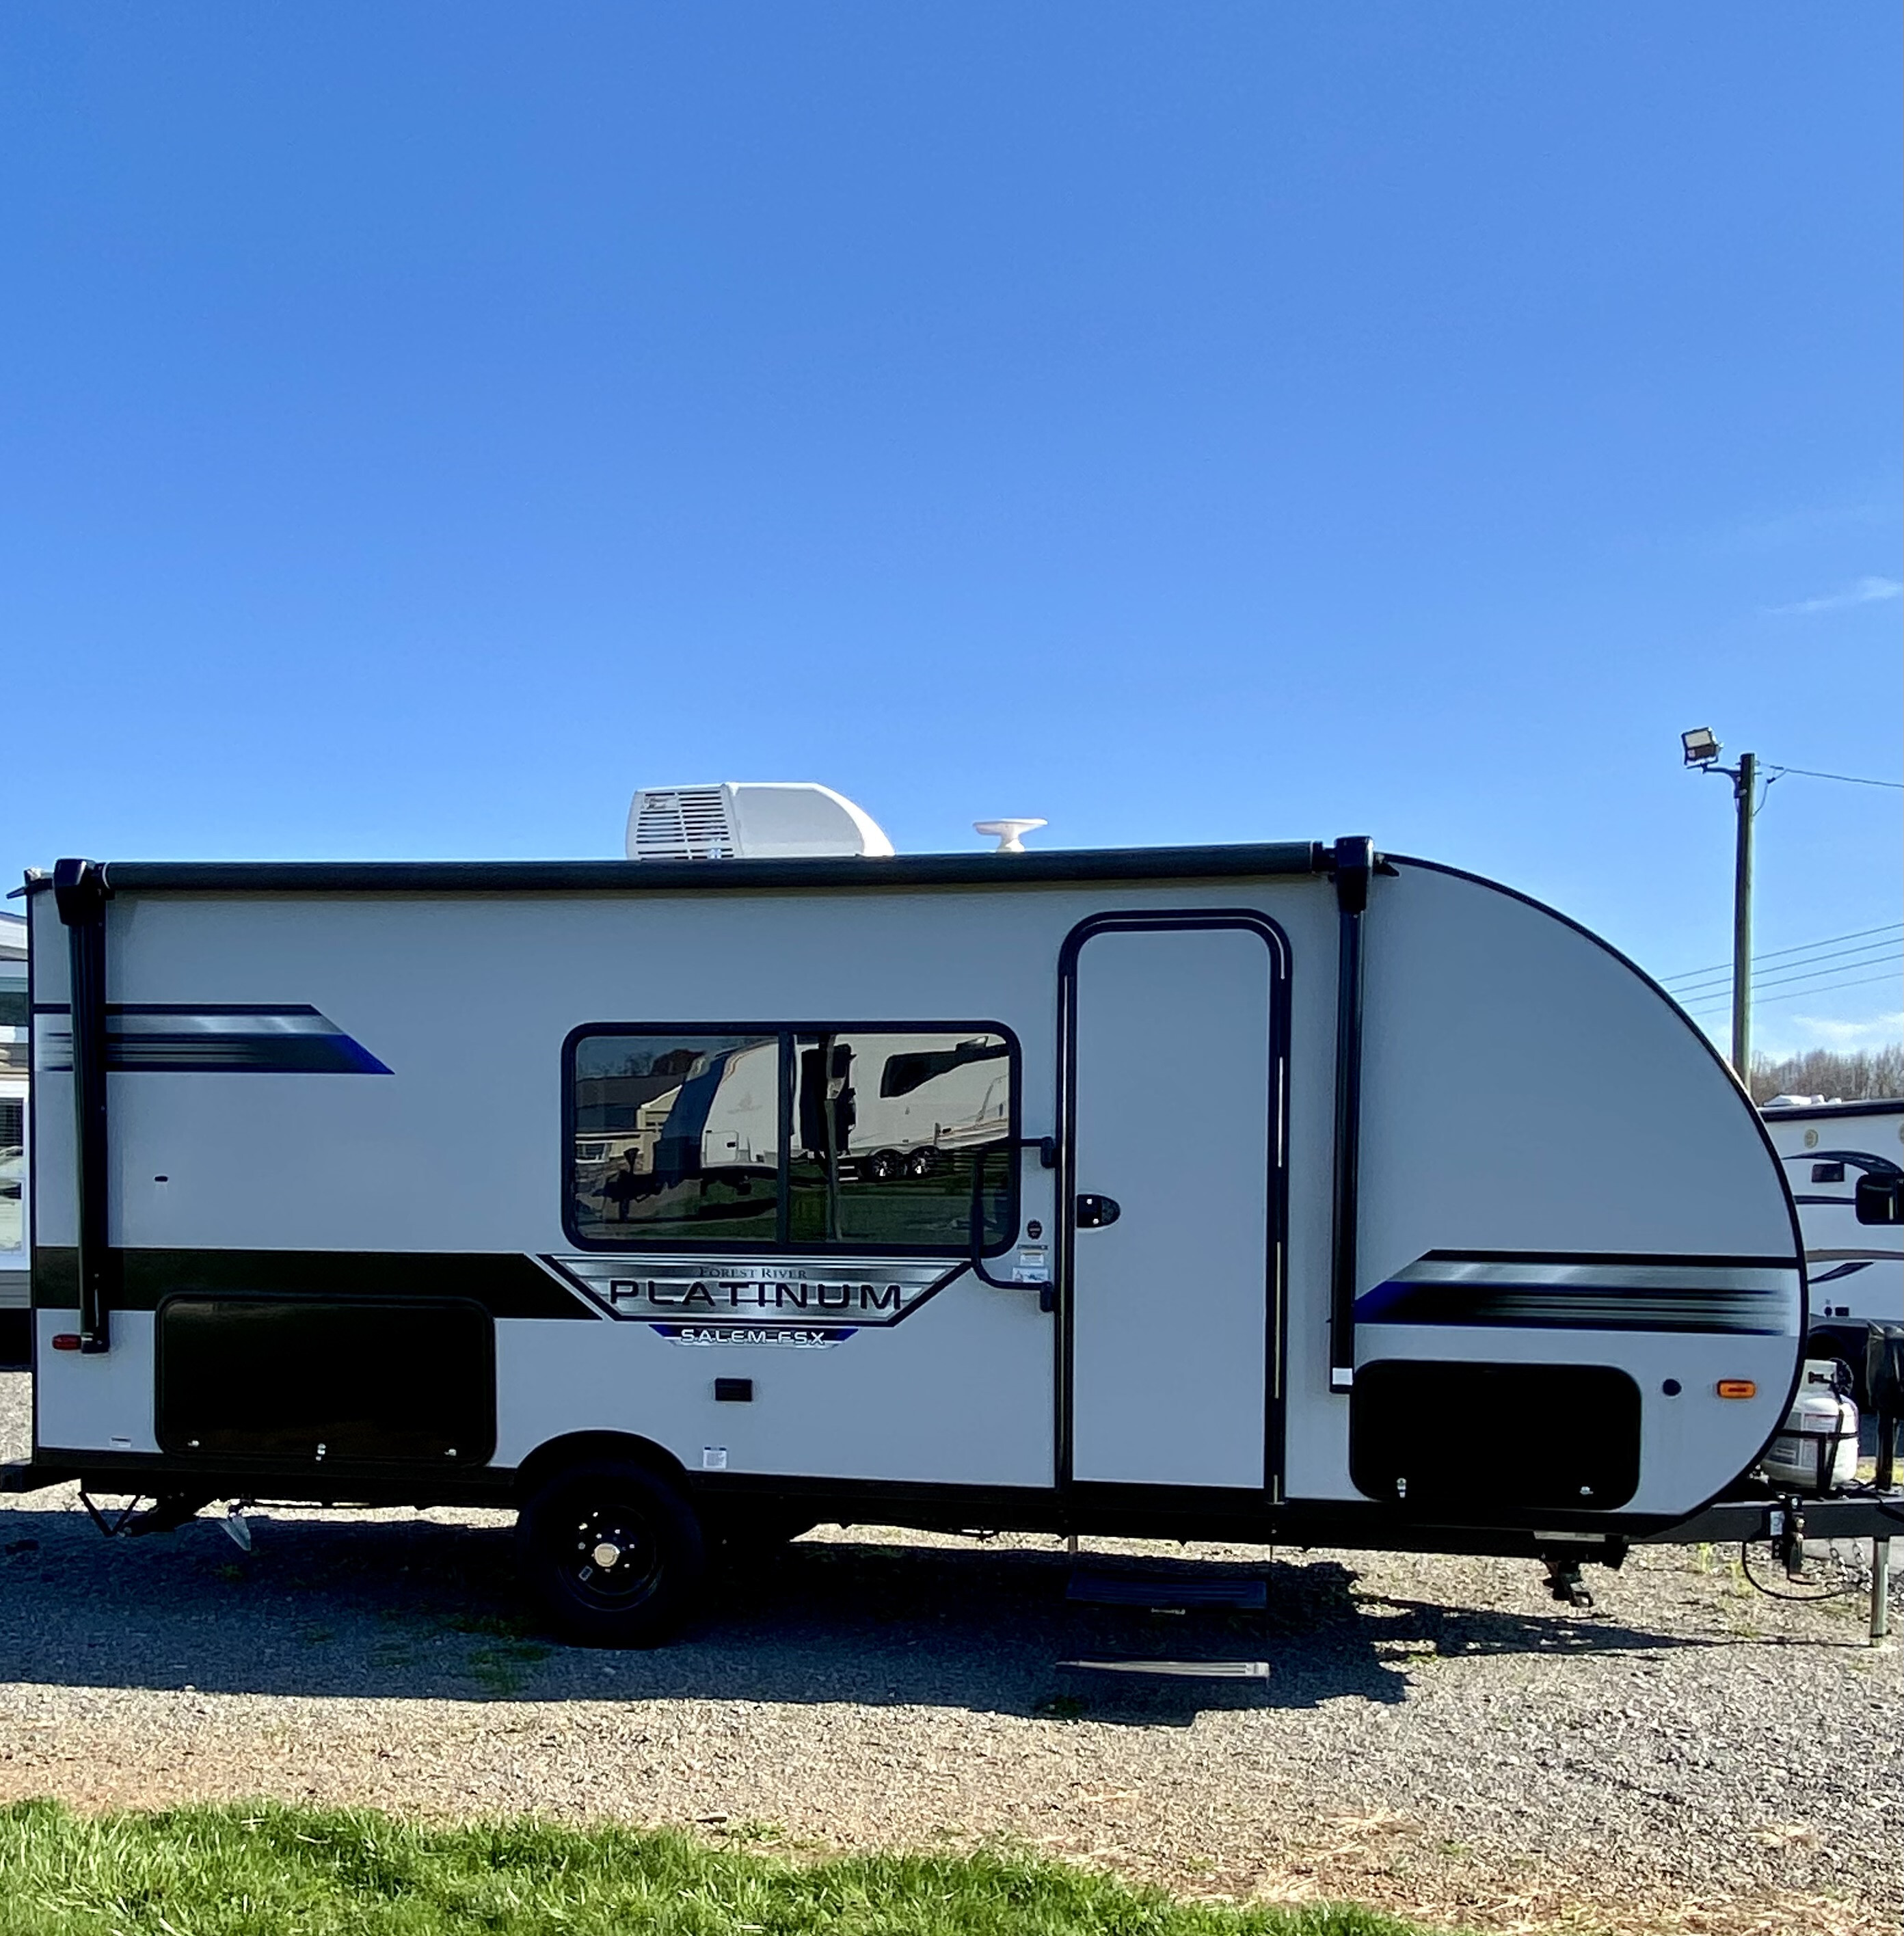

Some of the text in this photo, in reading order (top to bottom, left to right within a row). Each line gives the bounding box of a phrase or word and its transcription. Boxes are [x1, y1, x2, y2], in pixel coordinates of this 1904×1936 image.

[762, 1267, 807, 1279] RIVER
[610, 1280, 901, 1310] PLATINUM
[681, 1329, 824, 1345] SALEM FSX
